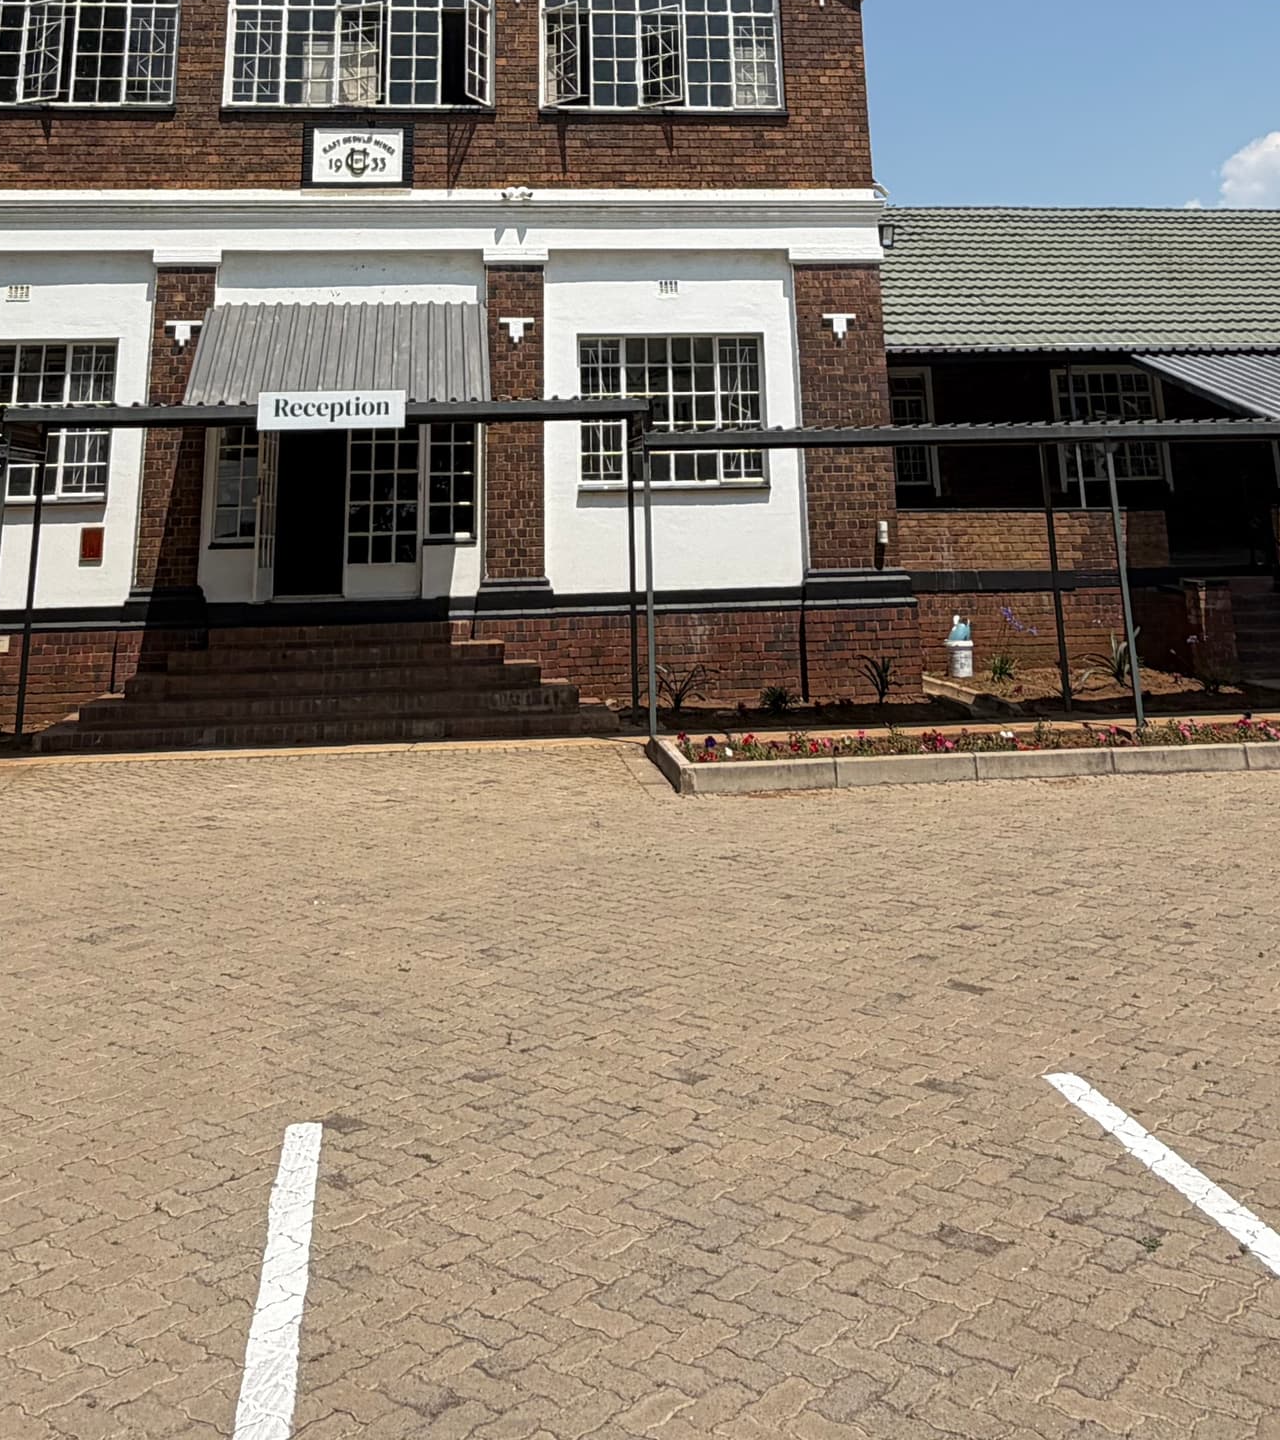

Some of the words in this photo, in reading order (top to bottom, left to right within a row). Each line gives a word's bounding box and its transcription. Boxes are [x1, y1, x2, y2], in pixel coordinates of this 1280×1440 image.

[322, 139, 341, 155] EAST
[373, 139, 396, 156] MINES
[328, 158, 343, 173] 19
[371, 157, 387, 172] 33
[273, 396, 390, 423] Reception
